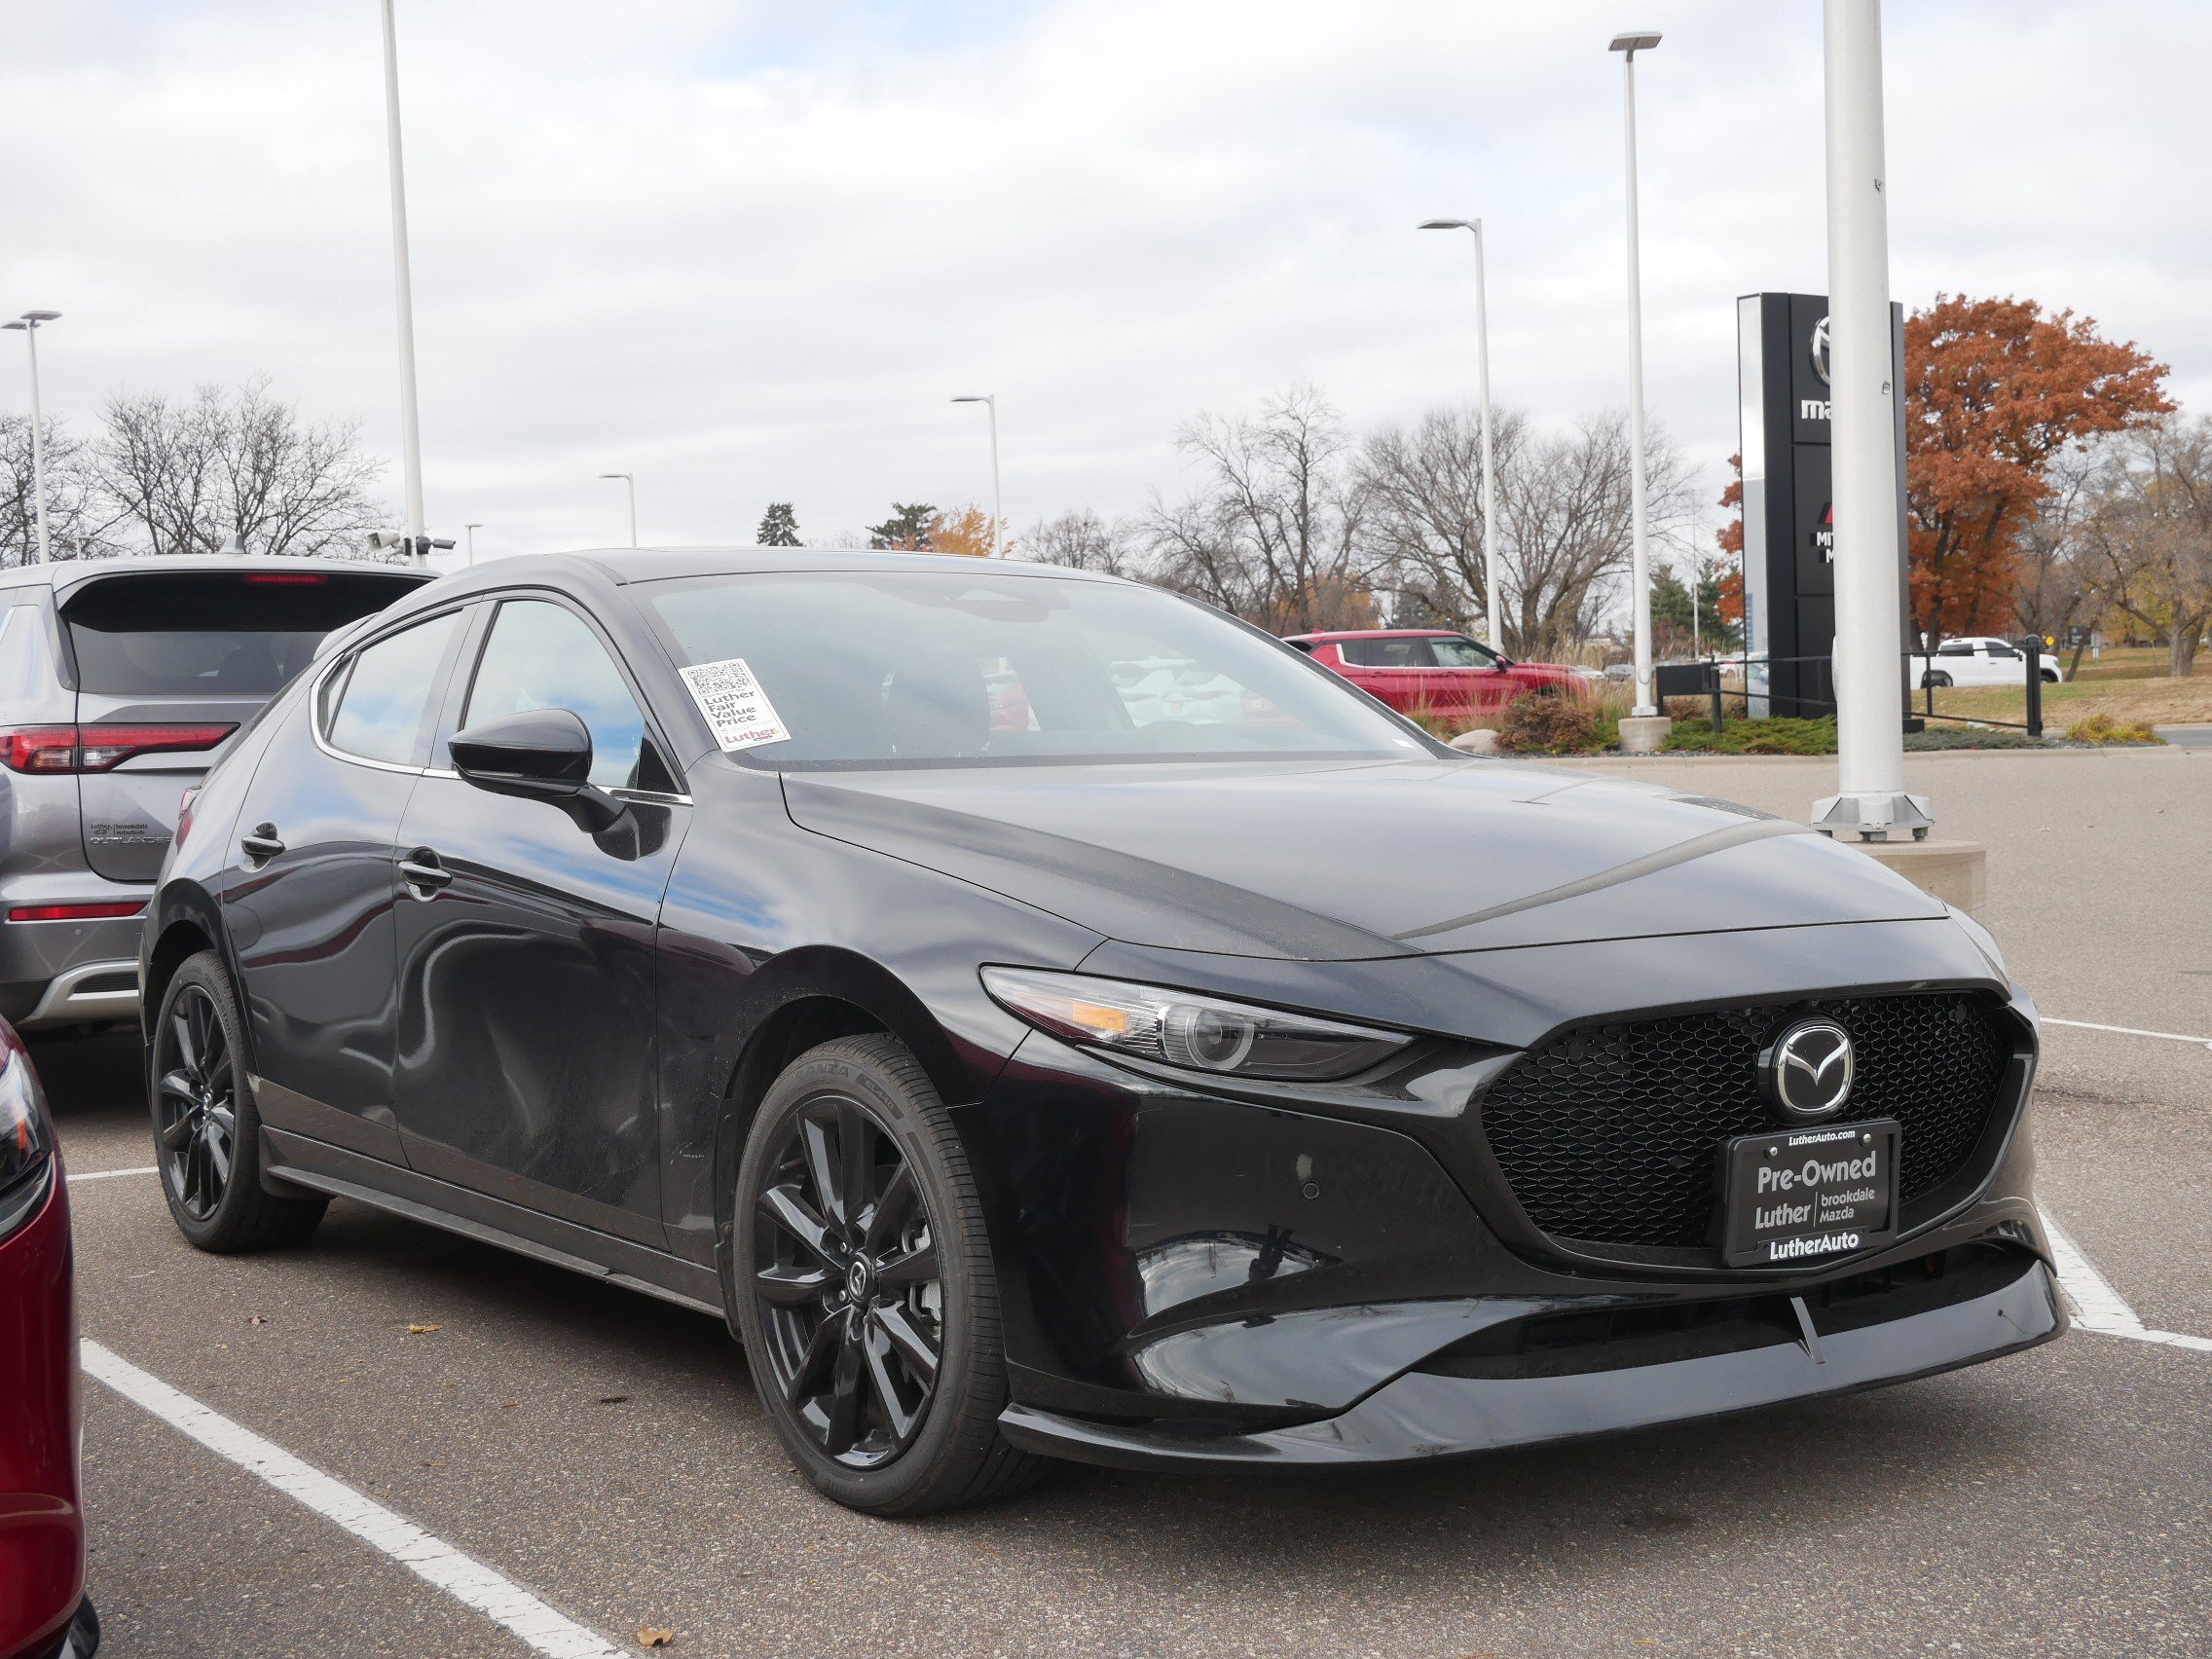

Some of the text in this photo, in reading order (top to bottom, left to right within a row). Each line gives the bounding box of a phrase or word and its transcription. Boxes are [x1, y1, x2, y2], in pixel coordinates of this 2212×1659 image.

[704, 691, 755, 705] Luther
[708, 702, 736, 713] Fair
[711, 707, 756, 719] Value
[716, 715, 756, 727] Price
[724, 728, 777, 744] Luther
[1788, 1130, 1856, 1147] LutherAuto.com
[1757, 1151, 1876, 1194] Pre-Owned
[1821, 1187, 1875, 1207] brookdale
[1754, 1202, 1811, 1230] Luther
[1819, 1206, 1855, 1224] Mazda
[1770, 1233, 1860, 1260] LutherAuto
